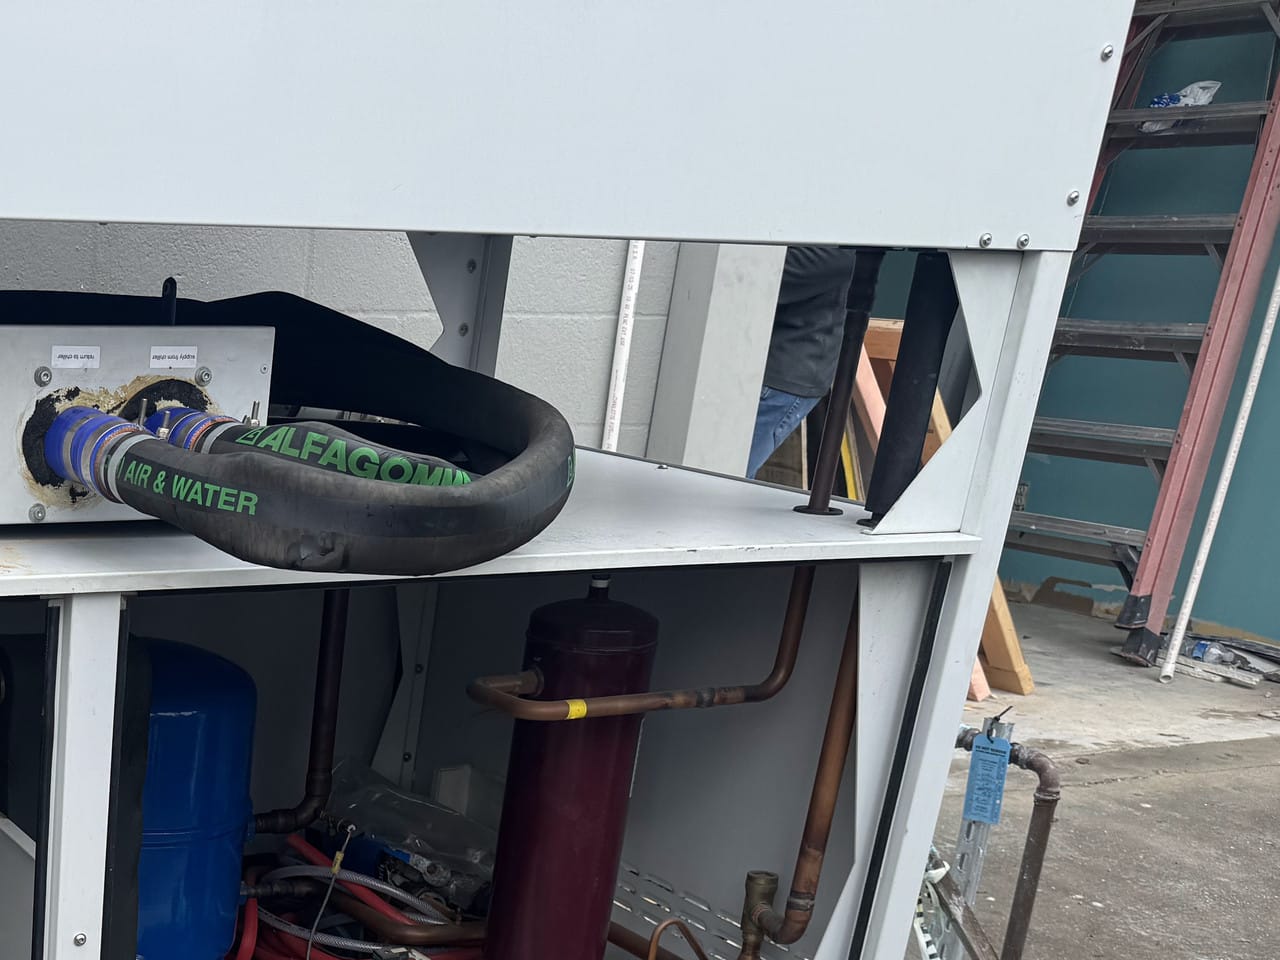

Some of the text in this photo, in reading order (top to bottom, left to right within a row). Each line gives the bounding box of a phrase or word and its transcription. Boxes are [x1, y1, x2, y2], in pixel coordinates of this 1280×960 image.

[125, 460, 152, 489] AIR
[153, 470, 166, 494] &
[172, 474, 258, 516] WATER
